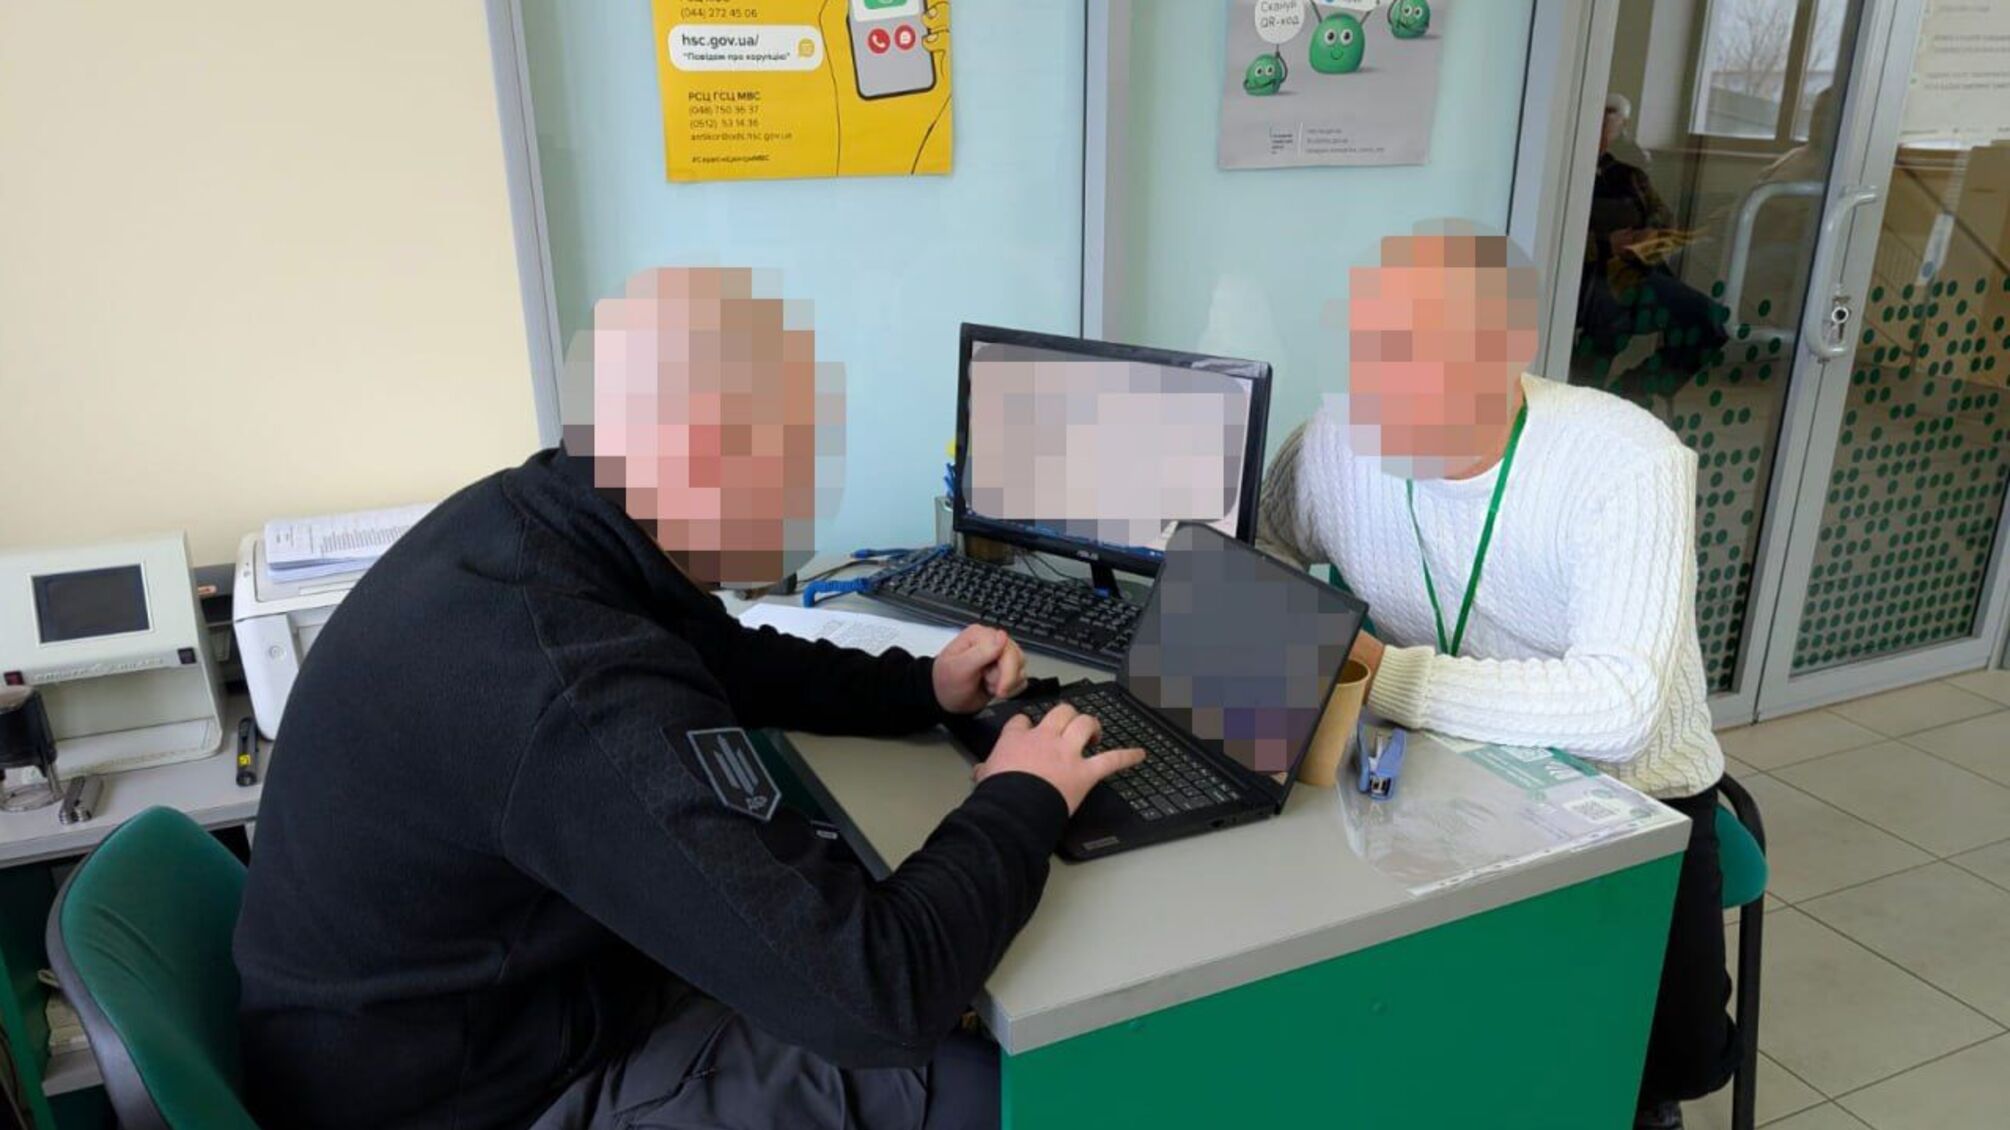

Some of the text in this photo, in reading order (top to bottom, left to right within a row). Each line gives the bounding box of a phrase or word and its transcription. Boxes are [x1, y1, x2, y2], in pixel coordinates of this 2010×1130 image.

[709, 8, 726, 17] 272
[682, 34, 759, 49] hsc.gov.ua/
[688, 91, 761, 102] РСЦ ГСЦ МВС
